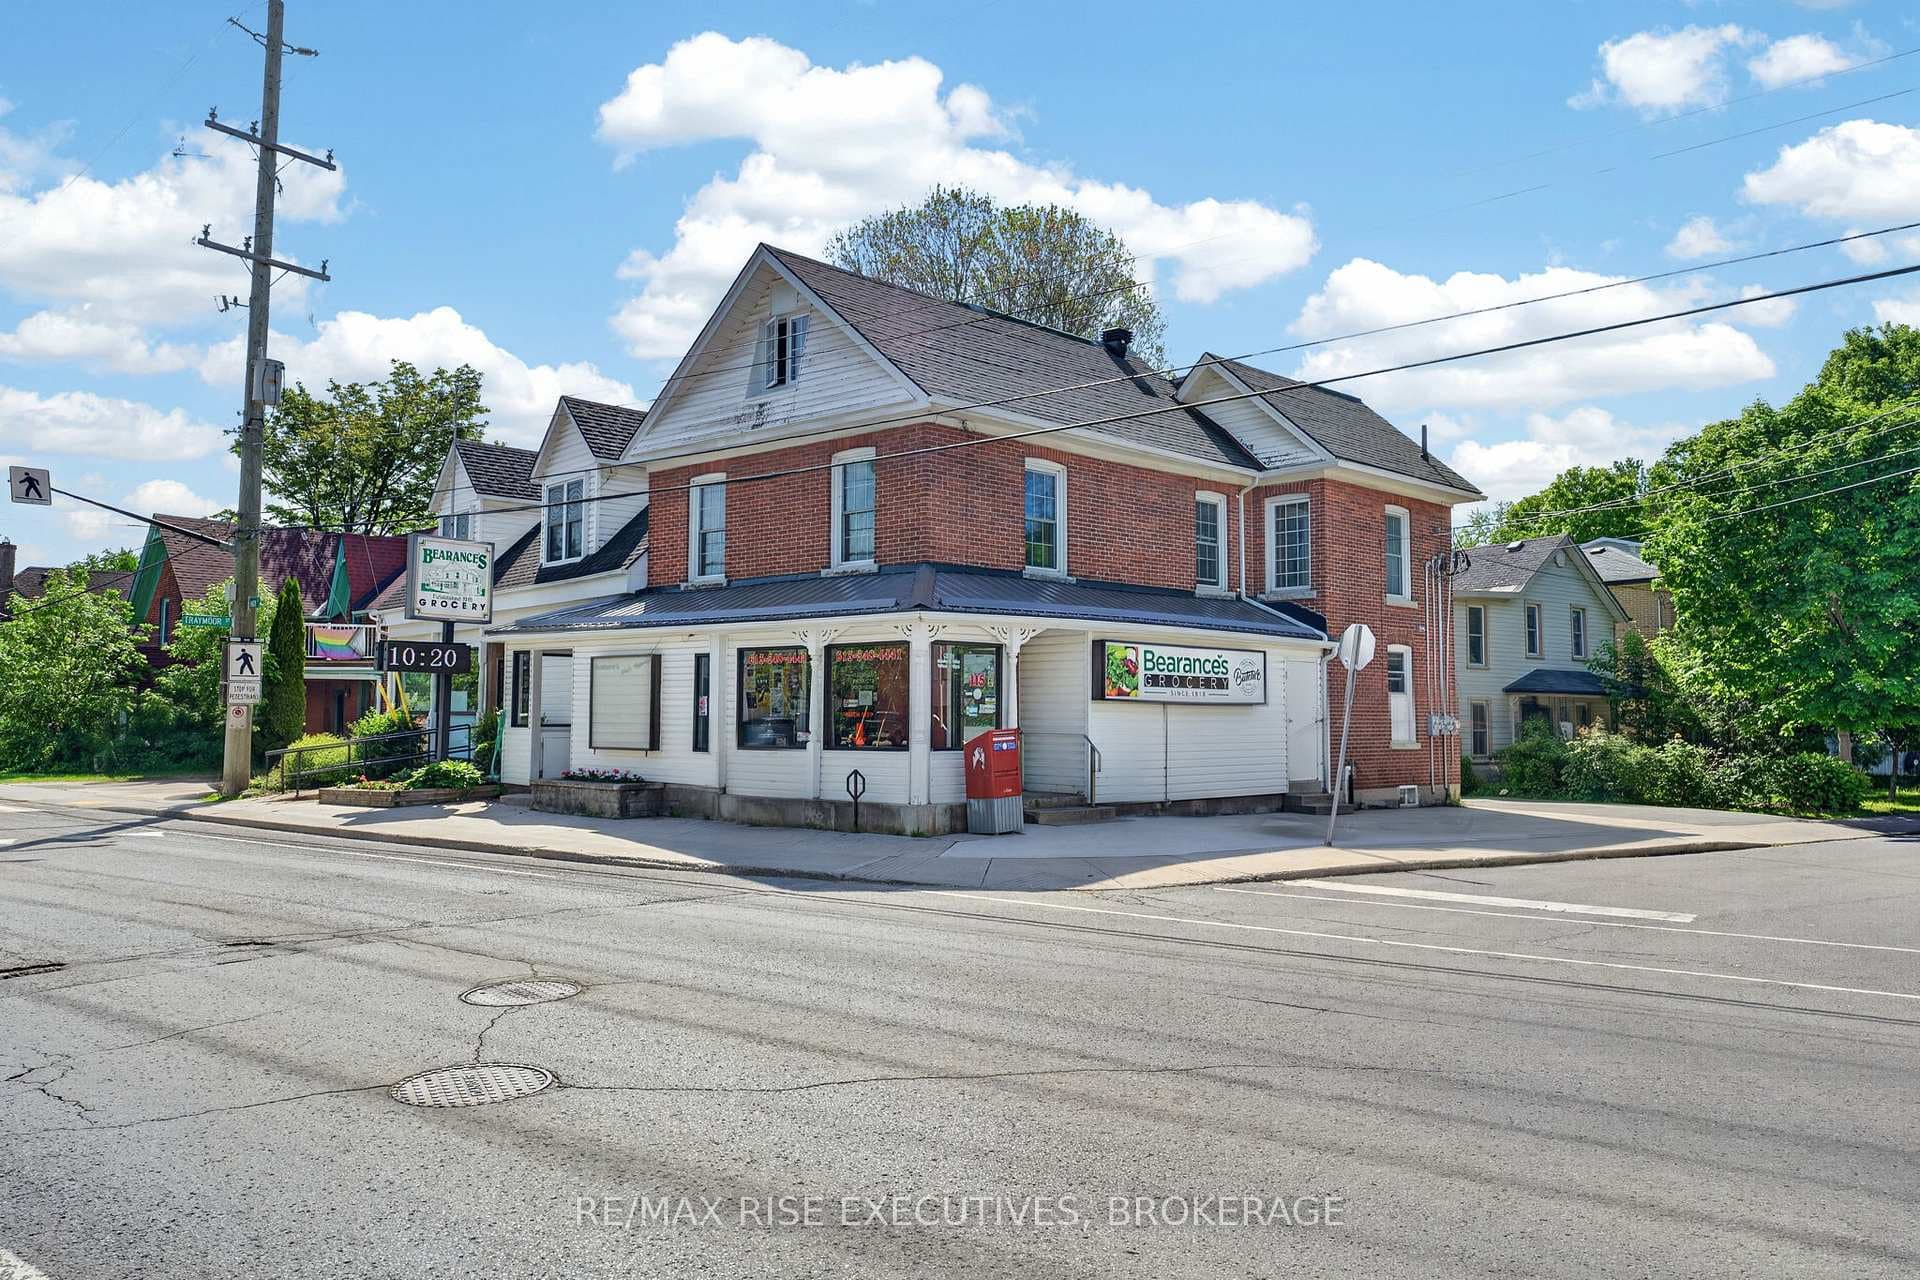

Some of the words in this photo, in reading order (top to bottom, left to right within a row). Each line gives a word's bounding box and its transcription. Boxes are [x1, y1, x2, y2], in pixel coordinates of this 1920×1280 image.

[419, 598, 486, 611] GROCERY
[185, 616, 222, 625] TRAYMOOR
[389, 647, 457, 667] 10:20
[1144, 674, 1229, 689] GROCERY
